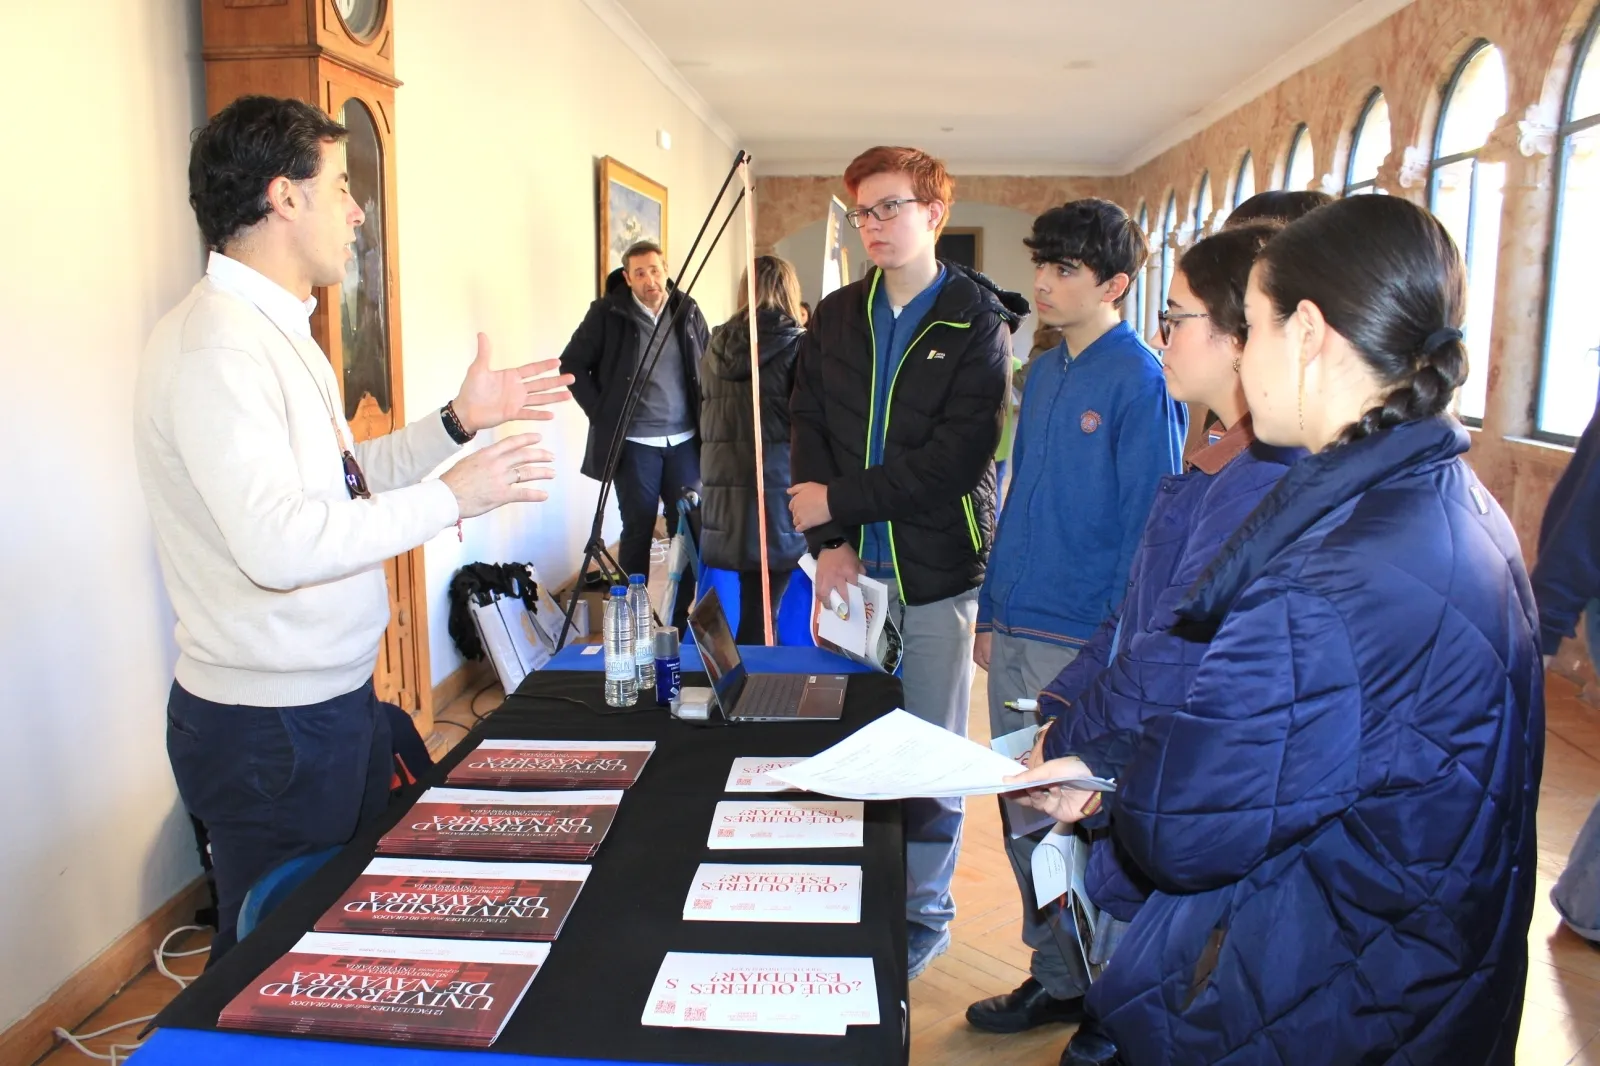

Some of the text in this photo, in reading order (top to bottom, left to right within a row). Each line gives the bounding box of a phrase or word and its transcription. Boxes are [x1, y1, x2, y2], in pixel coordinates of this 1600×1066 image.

[486, 756, 588, 765] NAVARRA
[468, 762, 627, 771] UNIVERSIDAD
[432, 816, 590, 826] DE NAVARRA
[804, 815, 852, 825] ¿QUÉ
[412, 822, 592, 834] UNIVERSIDAD
[718, 874, 830, 884] ESTUDIAR?
[700, 882, 847, 894] ¿QUÉ QUIERES
[368, 892, 548, 908] DE NAVARRA
[344, 901, 550, 918] UNIVERSIDAD
[346, 964, 415, 974] UNIVERSITARIA
[369, 968, 434, 978] PROTAGONISTA
[710, 972, 840, 983] ESTUDIAR?
[290, 971, 494, 996] DE NAVARRA
[690, 982, 794, 995] QUIERES
[800, 980, 862, 998] ¿QUÉ
[259, 982, 494, 1010] UNIVERSIDAD
[289, 1000, 330, 1008] GRADOS
[371, 1006, 433, 1015] FACULTADES
